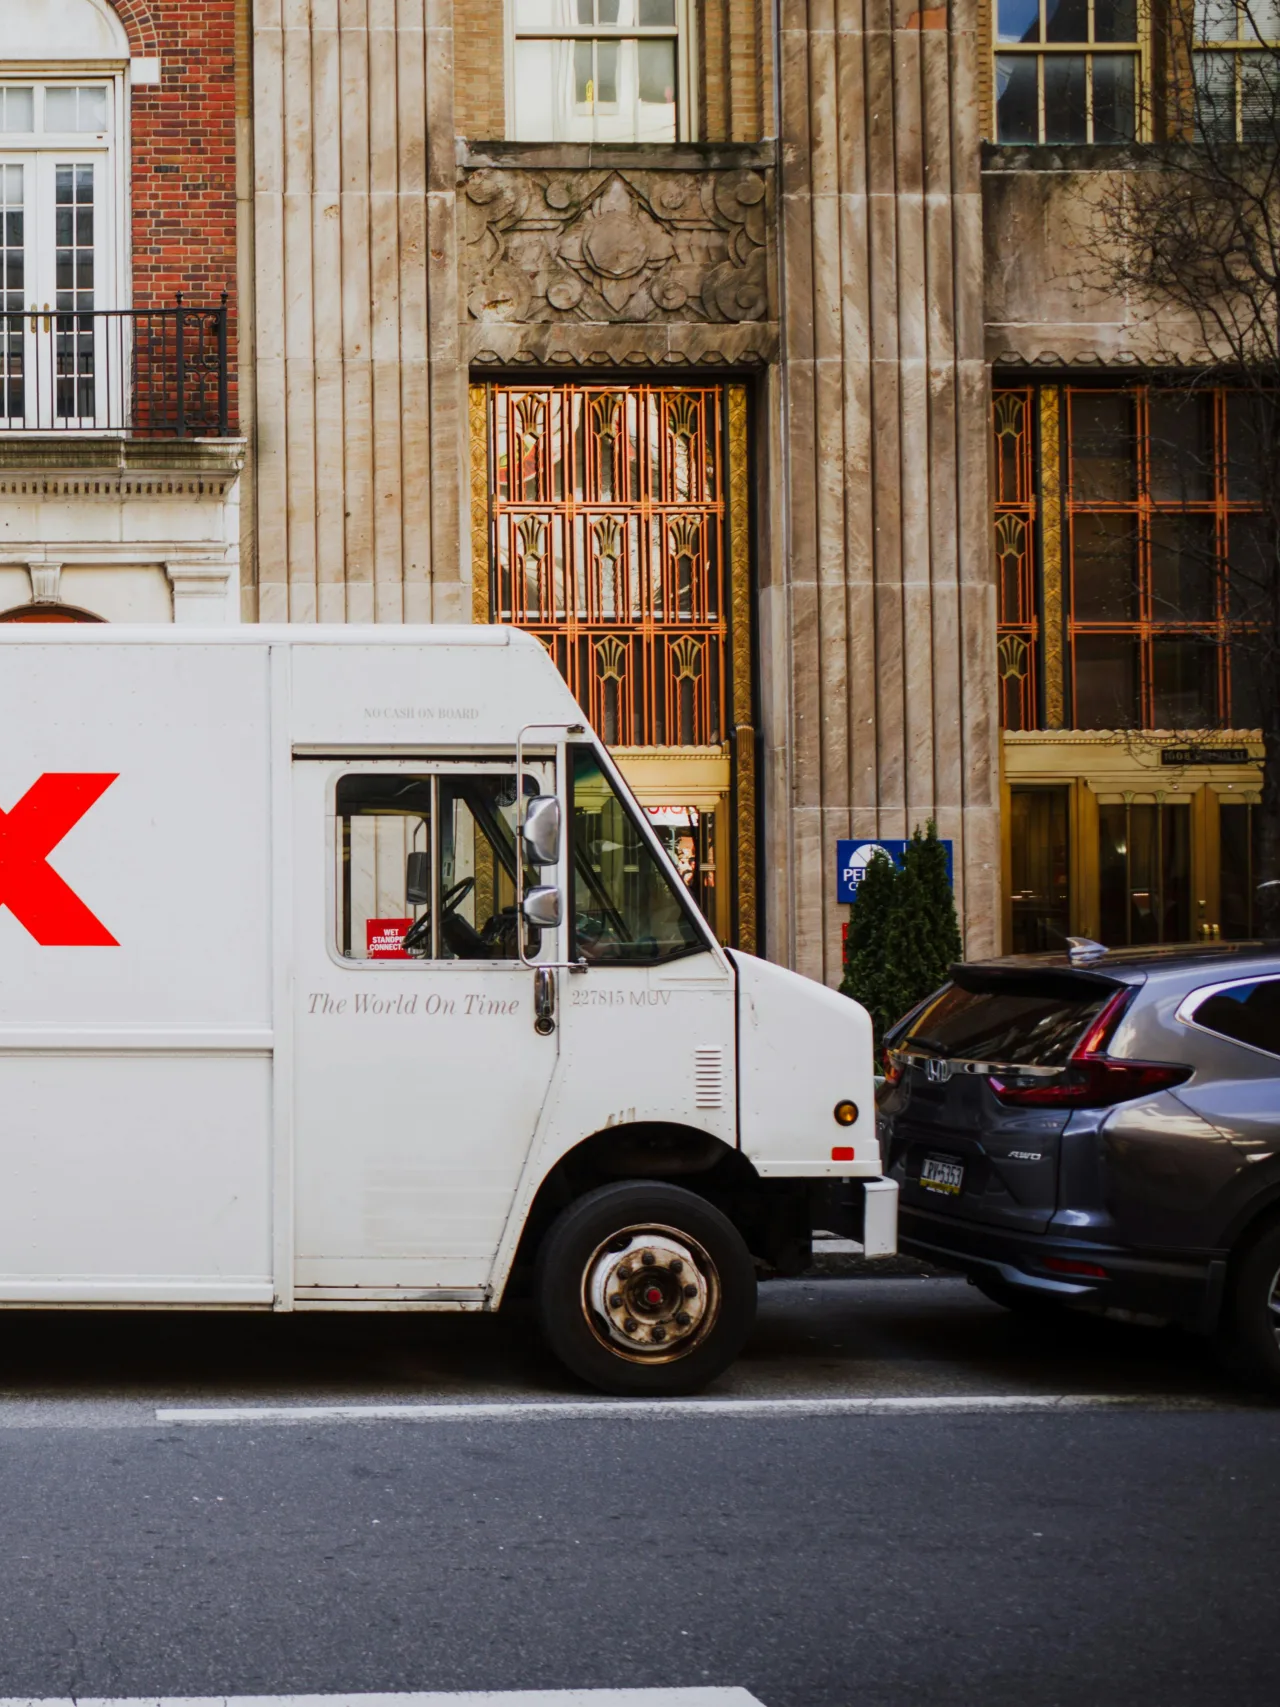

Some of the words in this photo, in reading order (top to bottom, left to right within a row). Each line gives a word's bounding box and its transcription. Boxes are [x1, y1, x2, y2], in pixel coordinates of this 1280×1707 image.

[364, 707, 380, 719] NO
[383, 707, 415, 719] CASH
[417, 707, 434, 719] ON
[438, 707, 479, 719] BOARD
[383, 928, 399, 936] WET
[308, 993, 347, 1014] The
[354, 993, 418, 1015] World
[425, 993, 456, 1015] On
[463, 993, 520, 1016] Time
[1008, 1150, 1042, 1160] AWD
